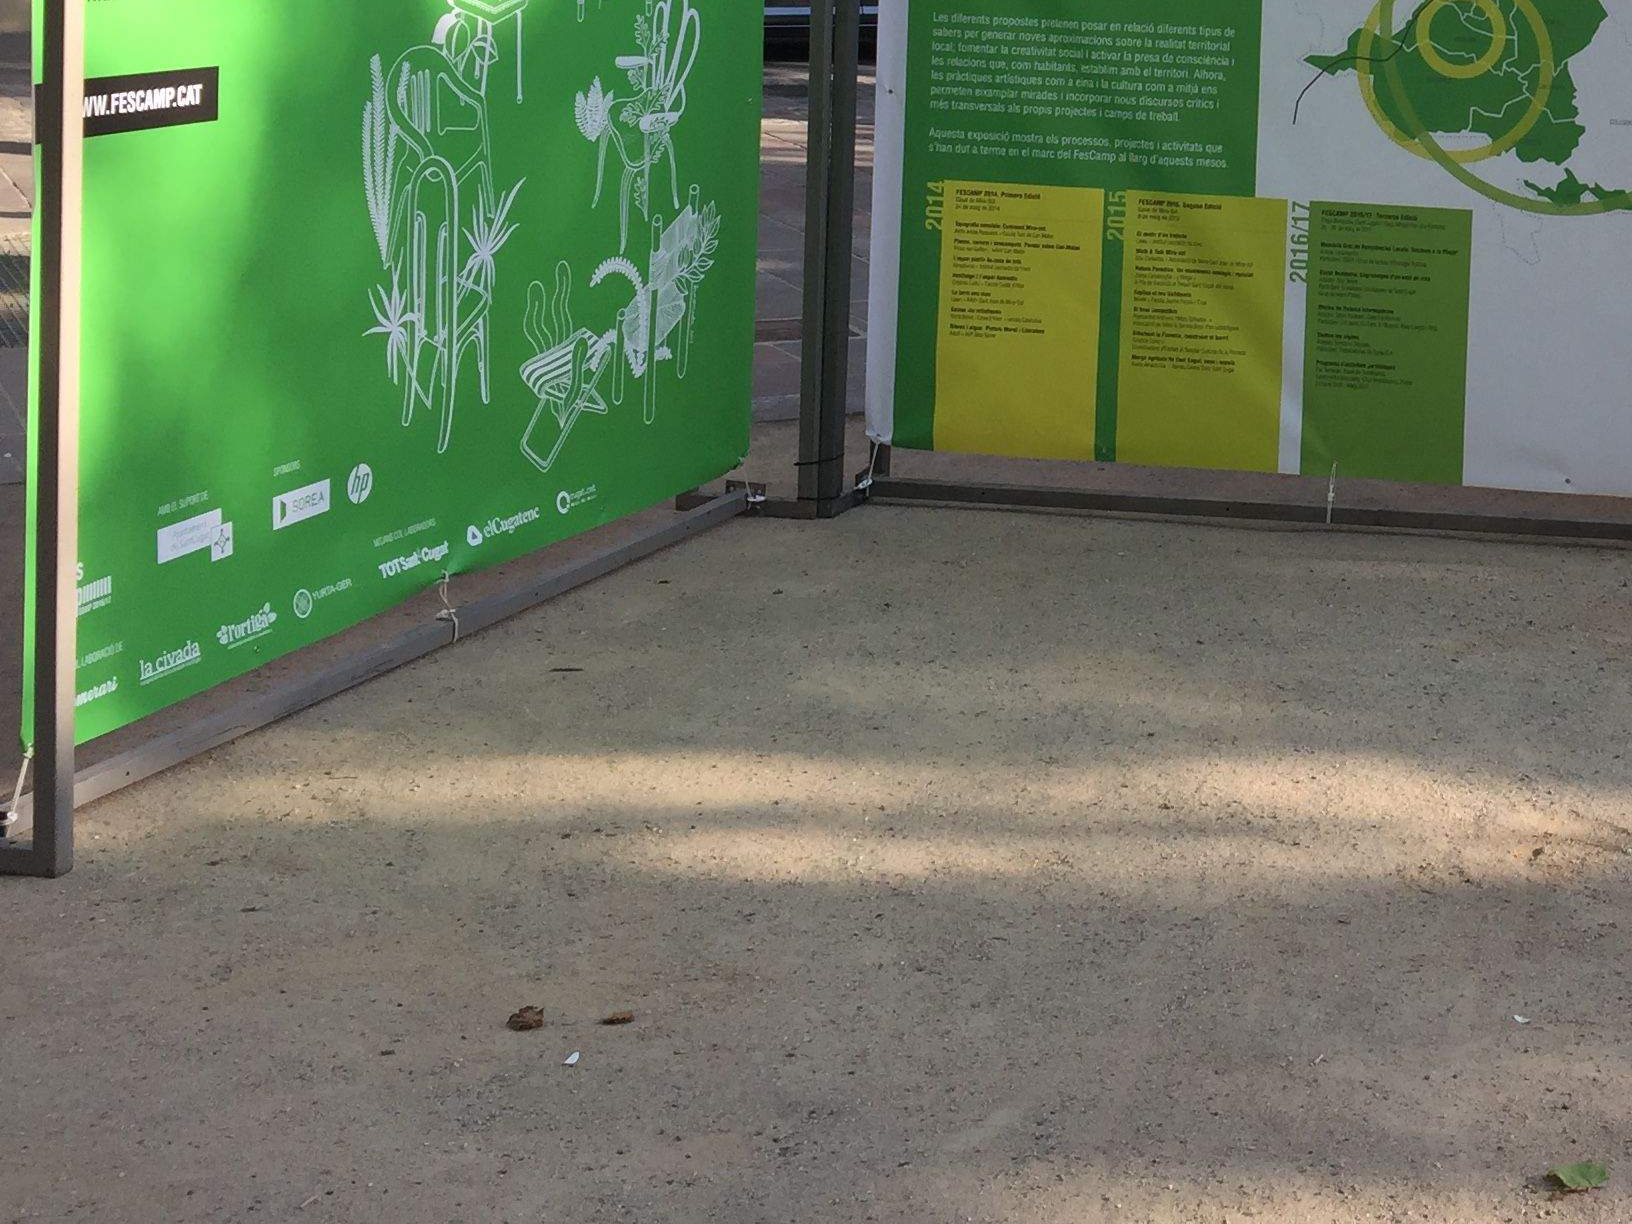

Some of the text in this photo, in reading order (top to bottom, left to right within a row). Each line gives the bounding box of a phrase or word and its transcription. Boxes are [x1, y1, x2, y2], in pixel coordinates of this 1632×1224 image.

[83, 83, 203, 118] WW.FESCAMP.CAT
[926, 180, 945, 231] 2014
[1107, 189, 1127, 241] 2015
[1290, 200, 1312, 284] 2016/17
[350, 466, 371, 496] hp
[139, 660, 153, 681] la
[156, 640, 201, 673] civada
